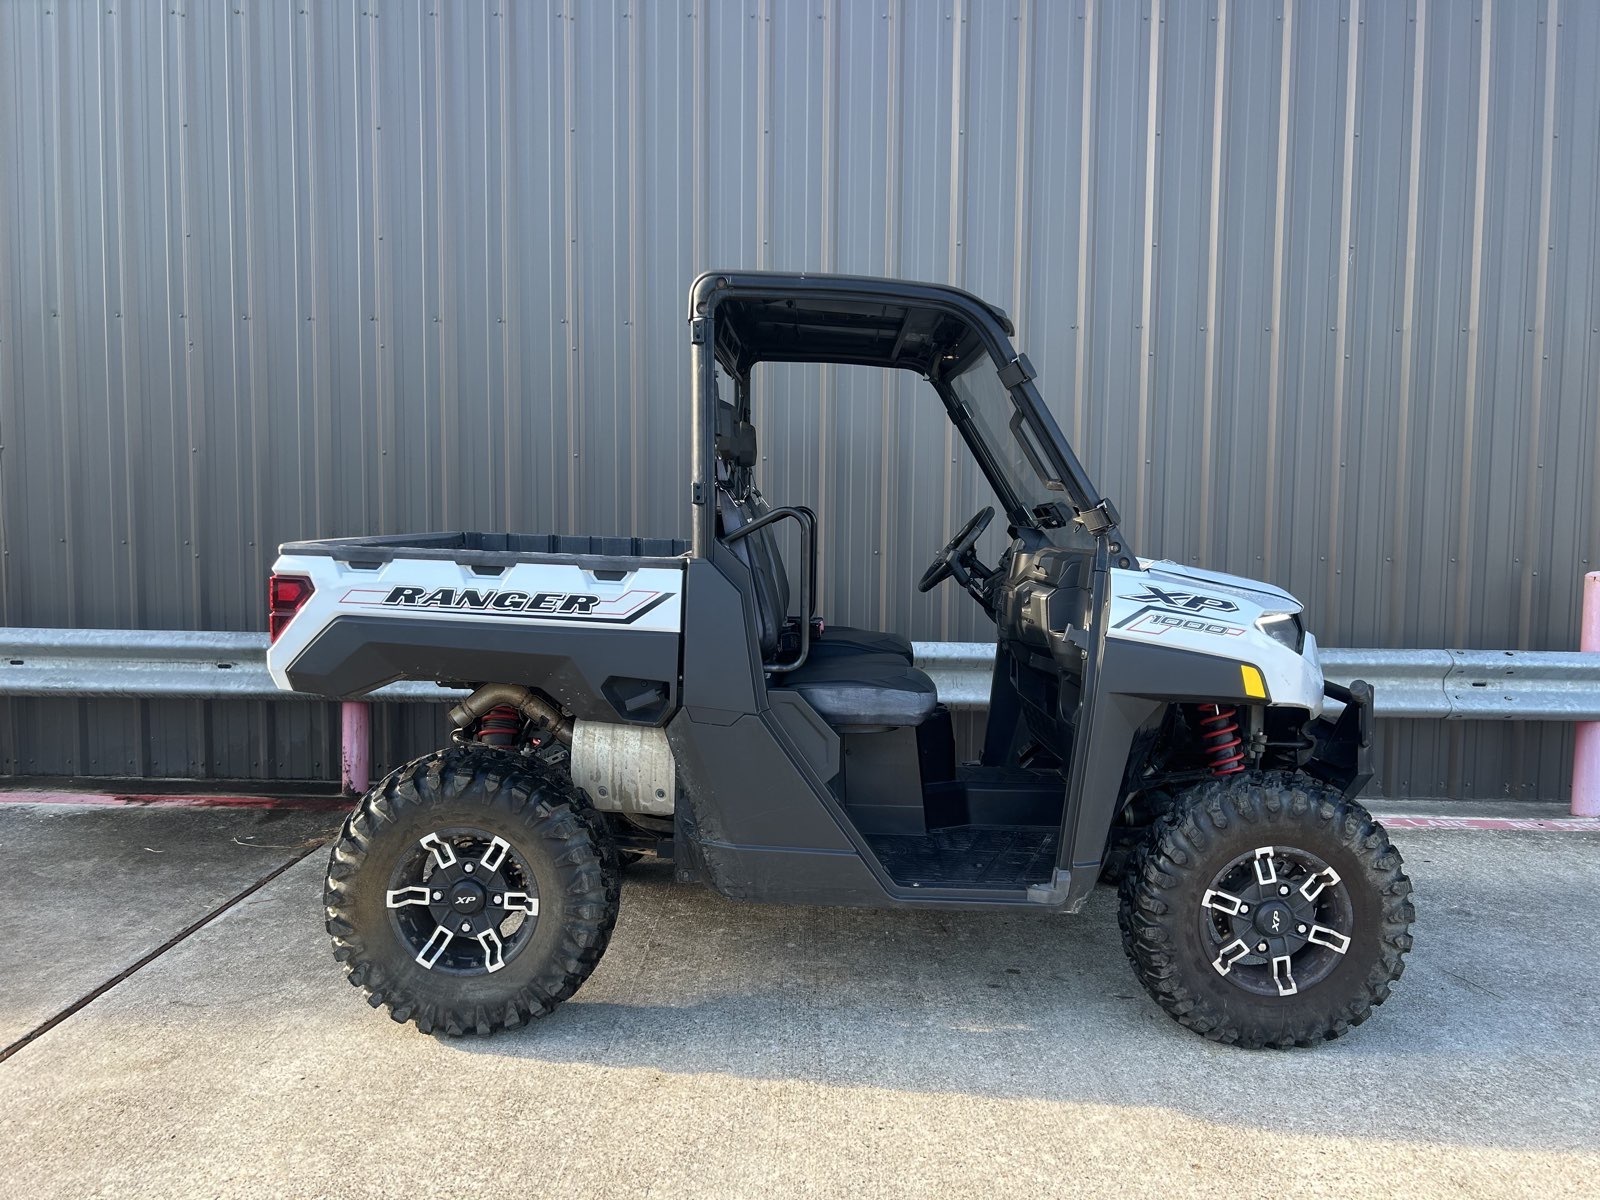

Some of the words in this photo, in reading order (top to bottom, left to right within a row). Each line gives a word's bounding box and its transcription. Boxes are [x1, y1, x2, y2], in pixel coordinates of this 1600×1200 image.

[382, 585, 600, 614] RANGER
[1117, 583, 1240, 612] XP
[1149, 615, 1229, 635] 1000
[1405, 818, 1480, 828] LANE
[455, 896, 477, 904] XP
[1271, 910, 1280, 932] XP
